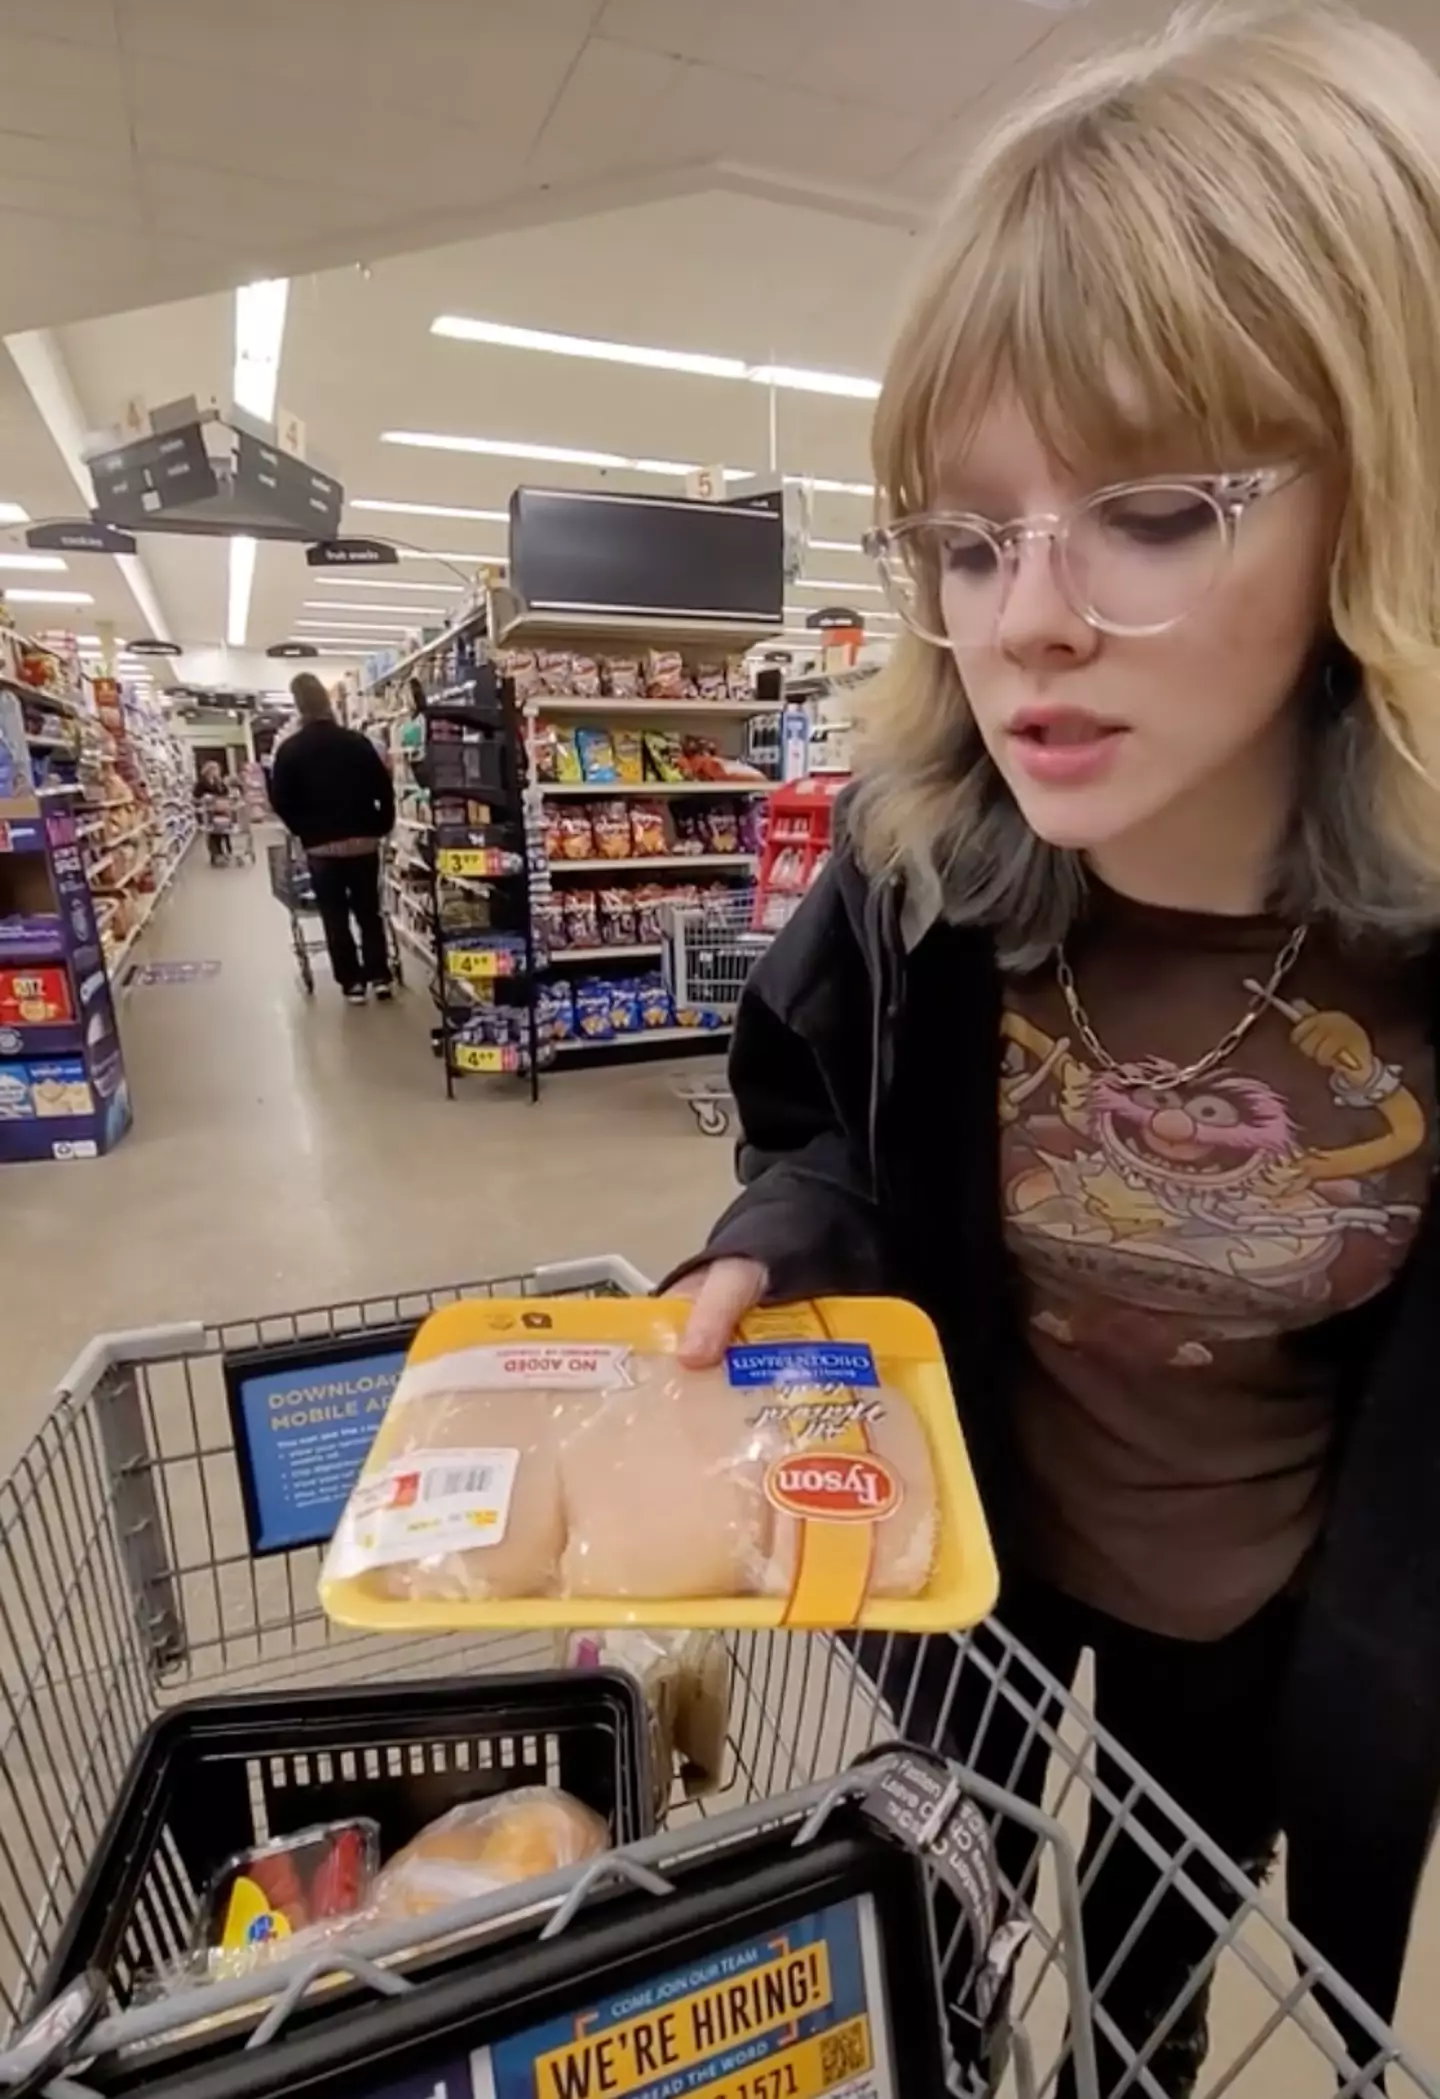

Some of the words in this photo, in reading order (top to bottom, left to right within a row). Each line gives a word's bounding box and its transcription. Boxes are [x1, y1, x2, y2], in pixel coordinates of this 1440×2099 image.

[698, 473, 712, 497] 5
[503, 1358, 563, 1373] ADDED
[568, 1358, 598, 1372] NO
[271, 1401, 360, 1431] MOBILE
[366, 1396, 394, 1413] AP
[779, 1463, 879, 1506] Tyson
[611, 1991, 652, 2018] COME
[655, 1978, 689, 2002] JOIN
[689, 1964, 720, 1986] OUR
[720, 1948, 759, 1973] TEAM
[551, 2012, 679, 2099] WE'RE
[691, 1952, 821, 2050] HIRING!
[686, 2063, 717, 2085] THE
[720, 2041, 769, 2071] WORD
